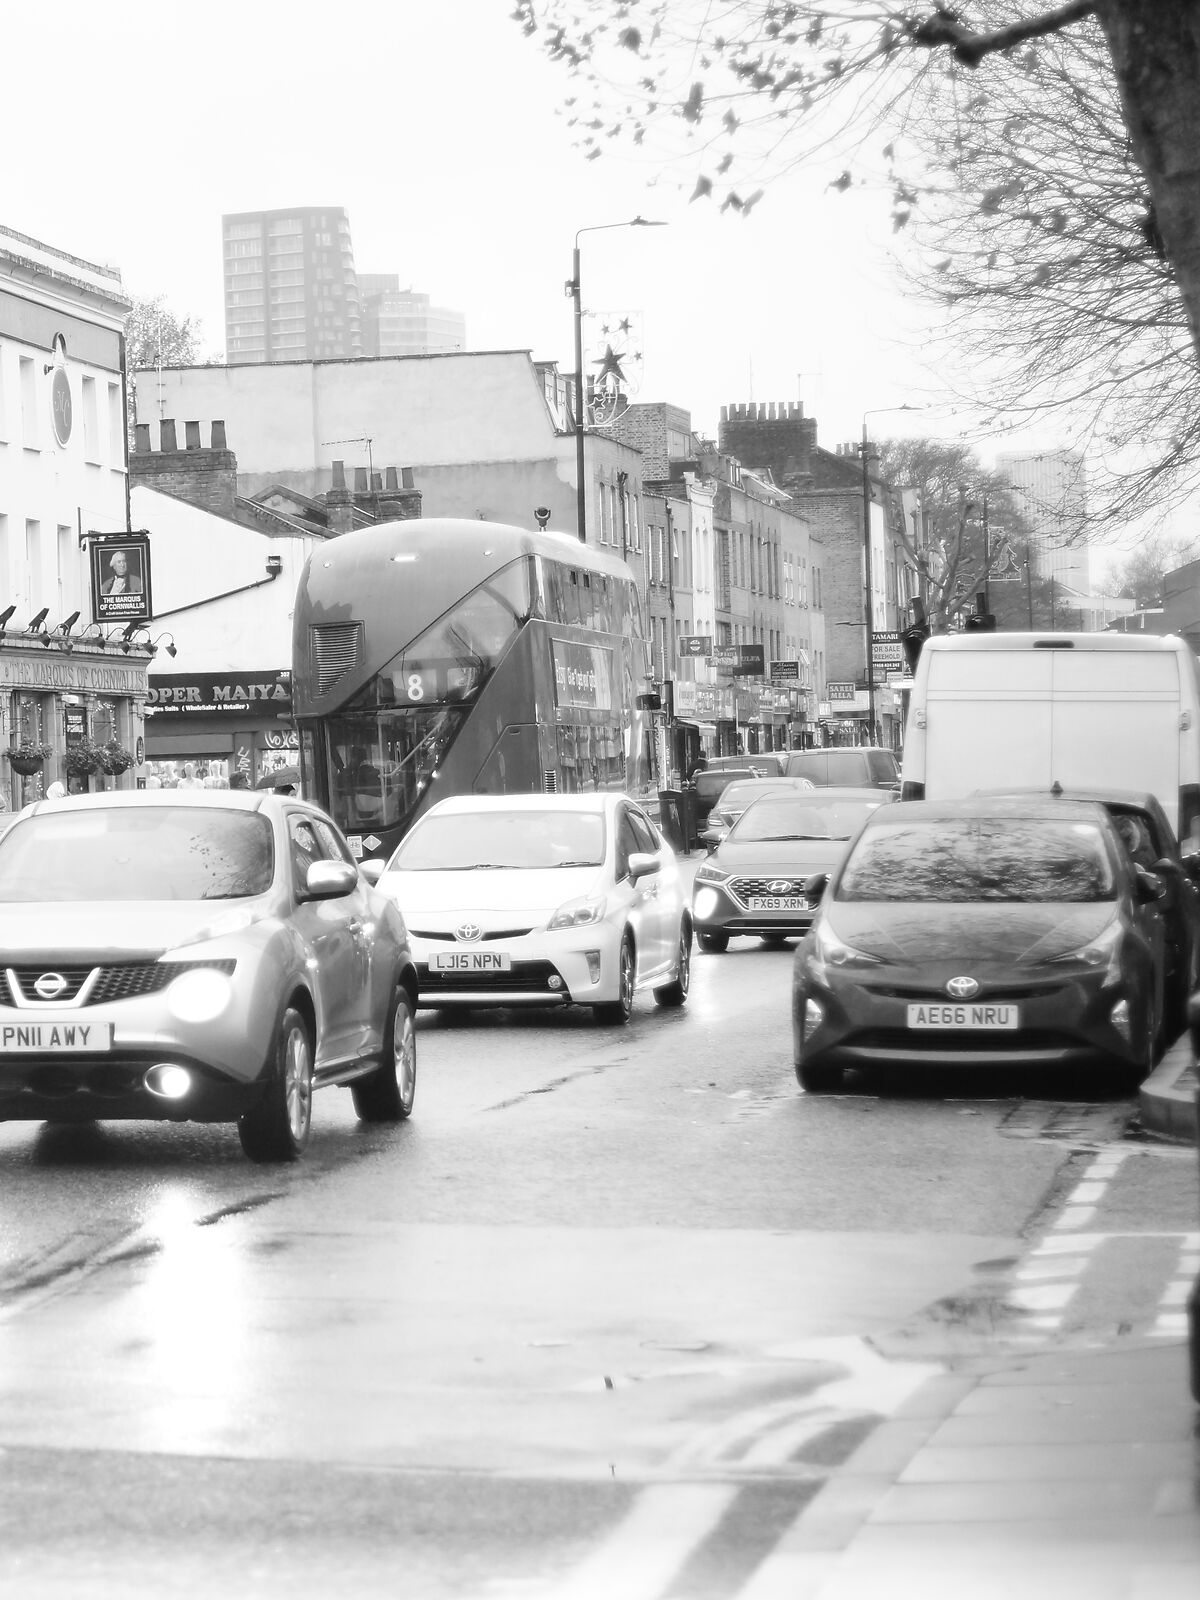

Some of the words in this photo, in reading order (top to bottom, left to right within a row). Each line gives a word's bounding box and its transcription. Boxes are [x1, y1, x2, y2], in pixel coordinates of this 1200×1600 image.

[108, 602, 145, 610] CORNWALLIS
[11, 662, 30, 684] THE
[33, 663, 74, 685] MARQUIS
[77, 667, 89, 686] OF
[92, 667, 144, 689] CORNWALLIS
[212, 684, 291, 701] MAIYA
[407, 674, 424, 701] 8
[753, 898, 780, 909] FX69
[783, 898, 803, 908] XRN
[436, 954, 469, 968] LJ15
[473, 954, 502, 968] NPN
[916, 1007, 965, 1024] AE66
[972, 1007, 1009, 1024] NRU
[2, 1026, 42, 1046] PN11
[50, 1026, 91, 1046] AWY
